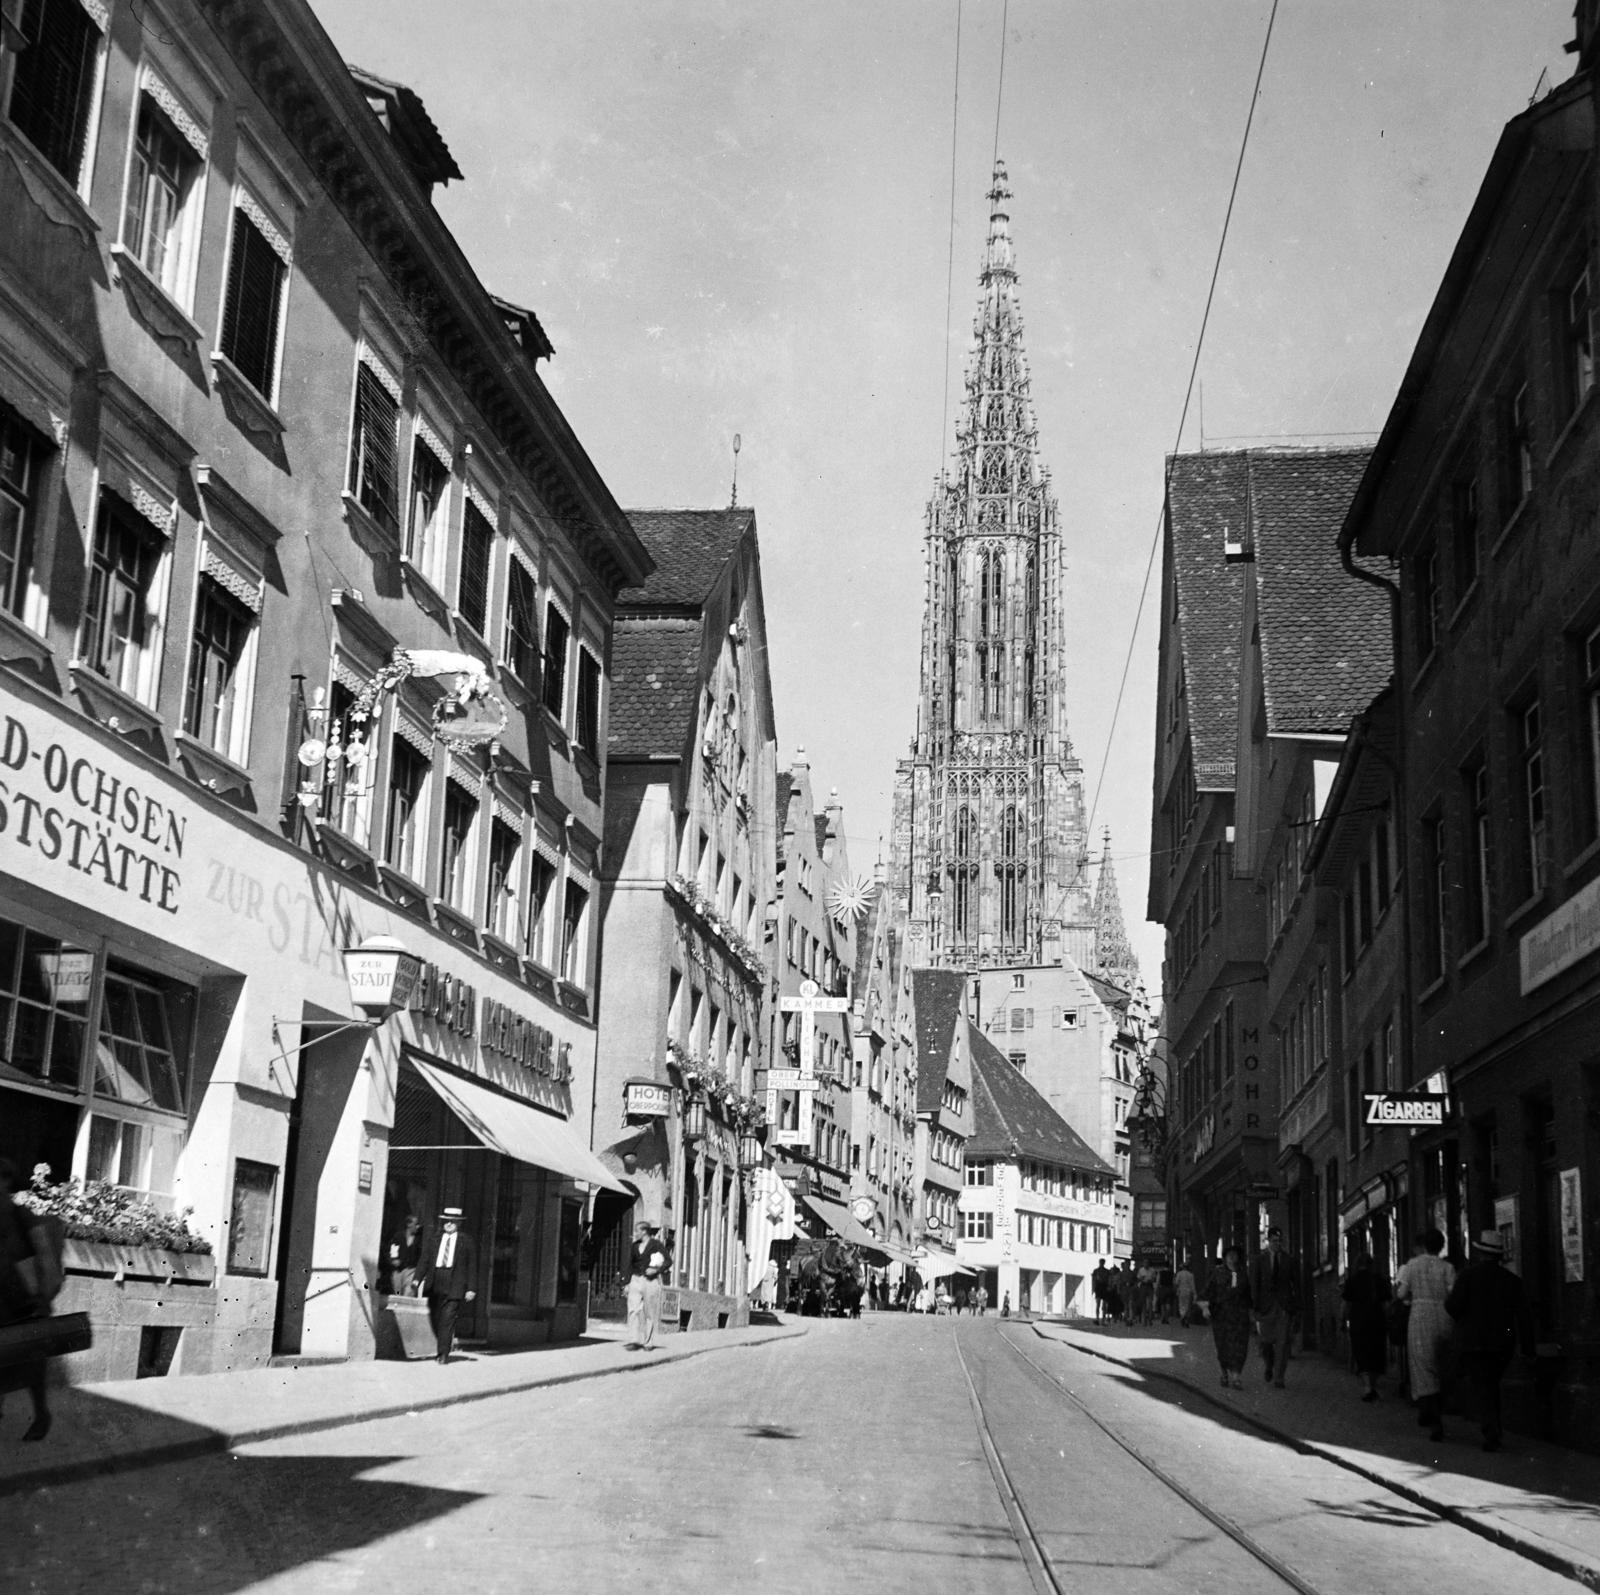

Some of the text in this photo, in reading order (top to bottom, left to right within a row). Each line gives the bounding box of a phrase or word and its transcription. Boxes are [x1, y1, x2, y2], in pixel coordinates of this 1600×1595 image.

[206, 857, 264, 924] ZUR
[351, 972, 393, 987] STADT
[783, 999, 844, 1009] KAMMER
[767, 1091, 775, 1122] HOTEL
